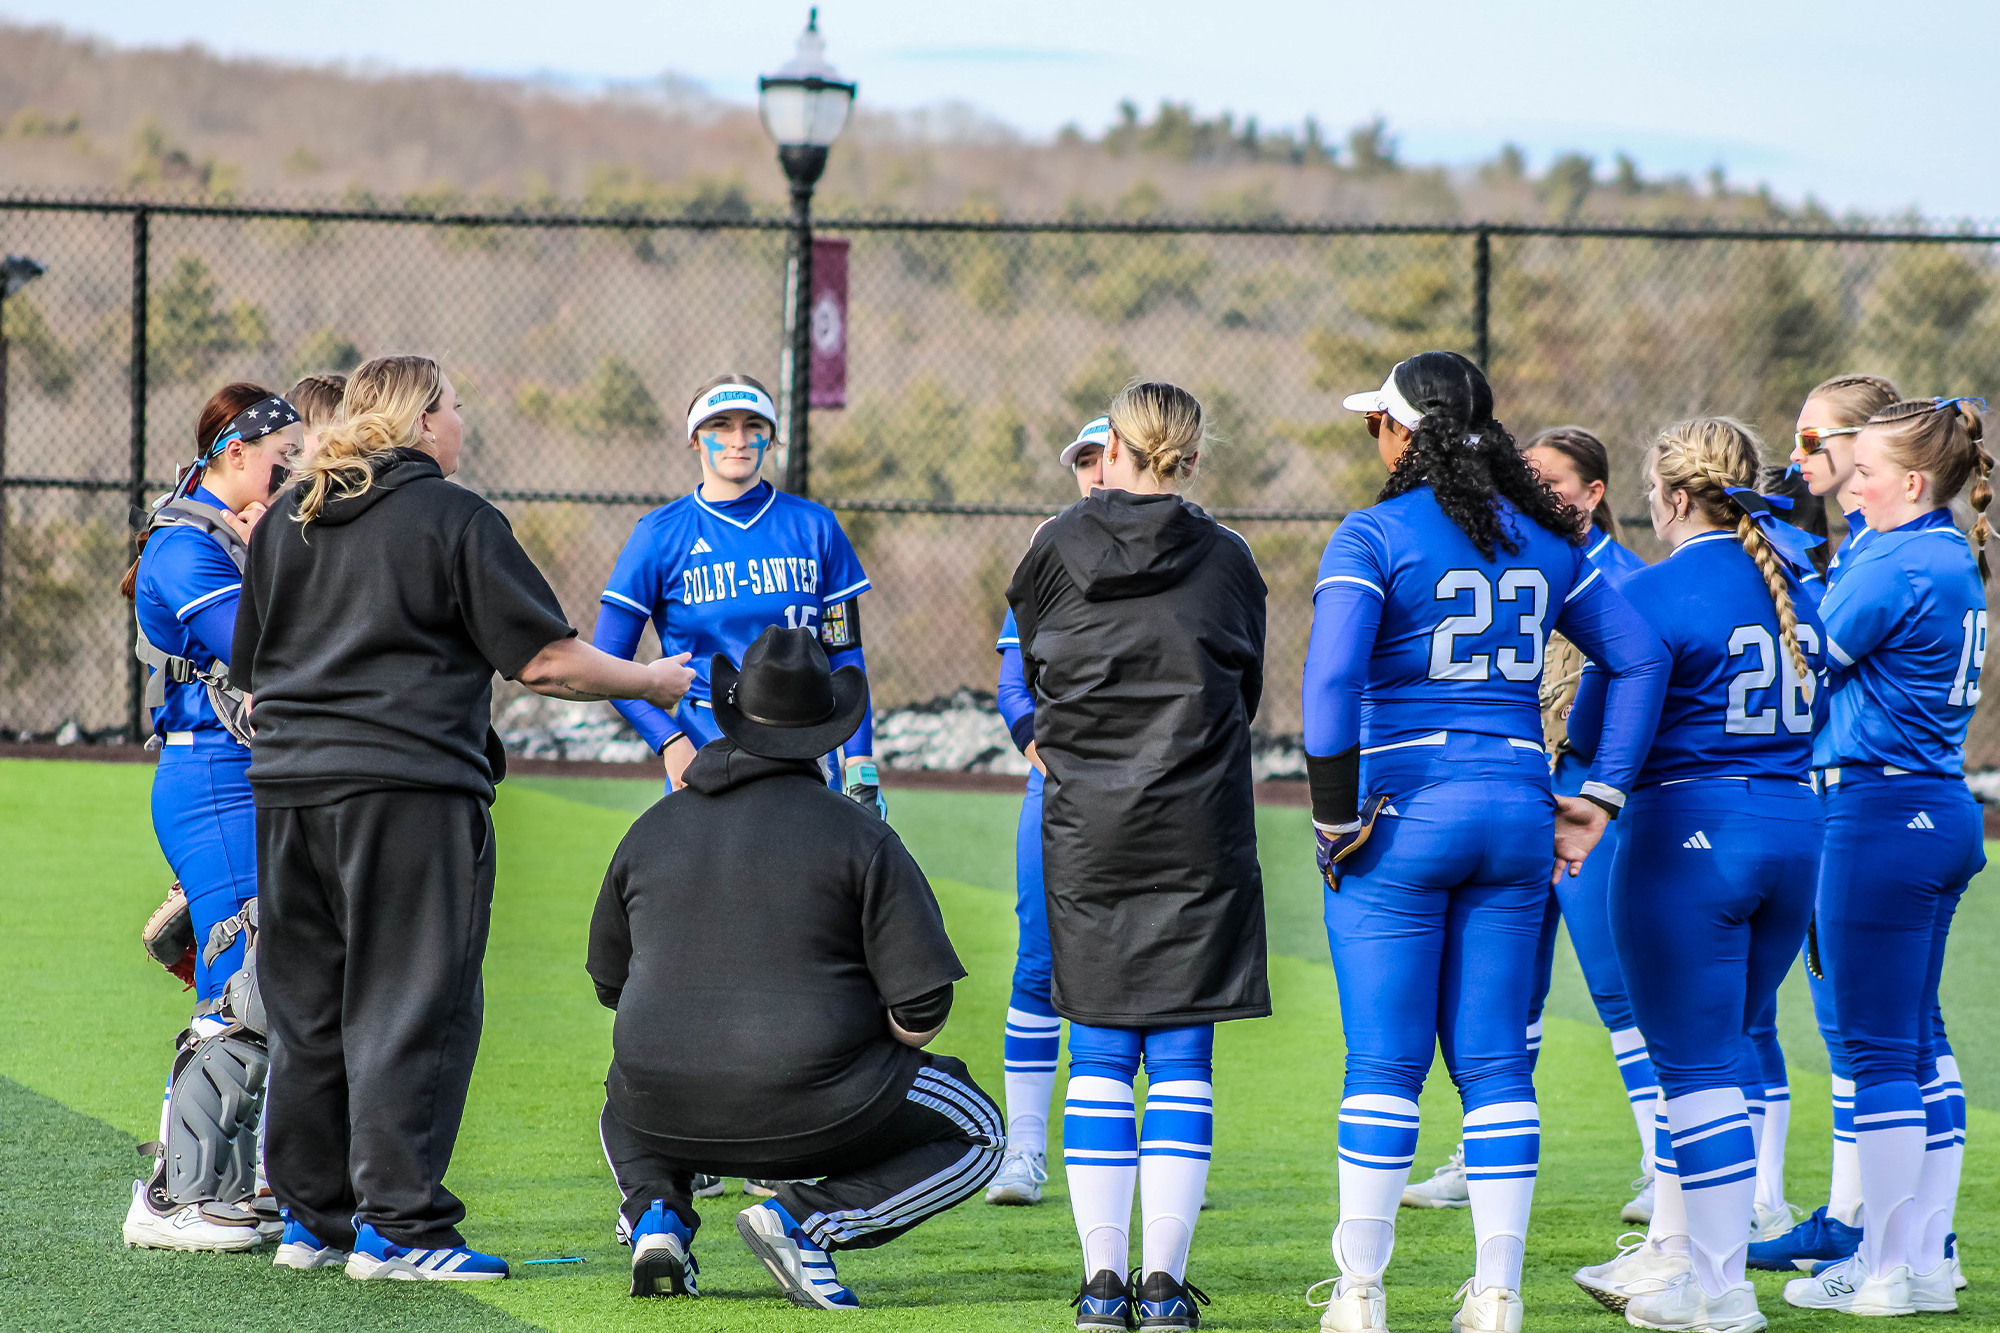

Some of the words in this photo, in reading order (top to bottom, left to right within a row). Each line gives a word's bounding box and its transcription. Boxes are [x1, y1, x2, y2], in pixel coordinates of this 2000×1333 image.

[708, 391, 758, 407] CHARGE
[682, 556, 818, 606] COLBY-SAWYER
[783, 604, 818, 640] 15
[1427, 568, 1549, 682] 23
[1946, 608, 1988, 707] 19
[1723, 622, 1819, 735] 26
